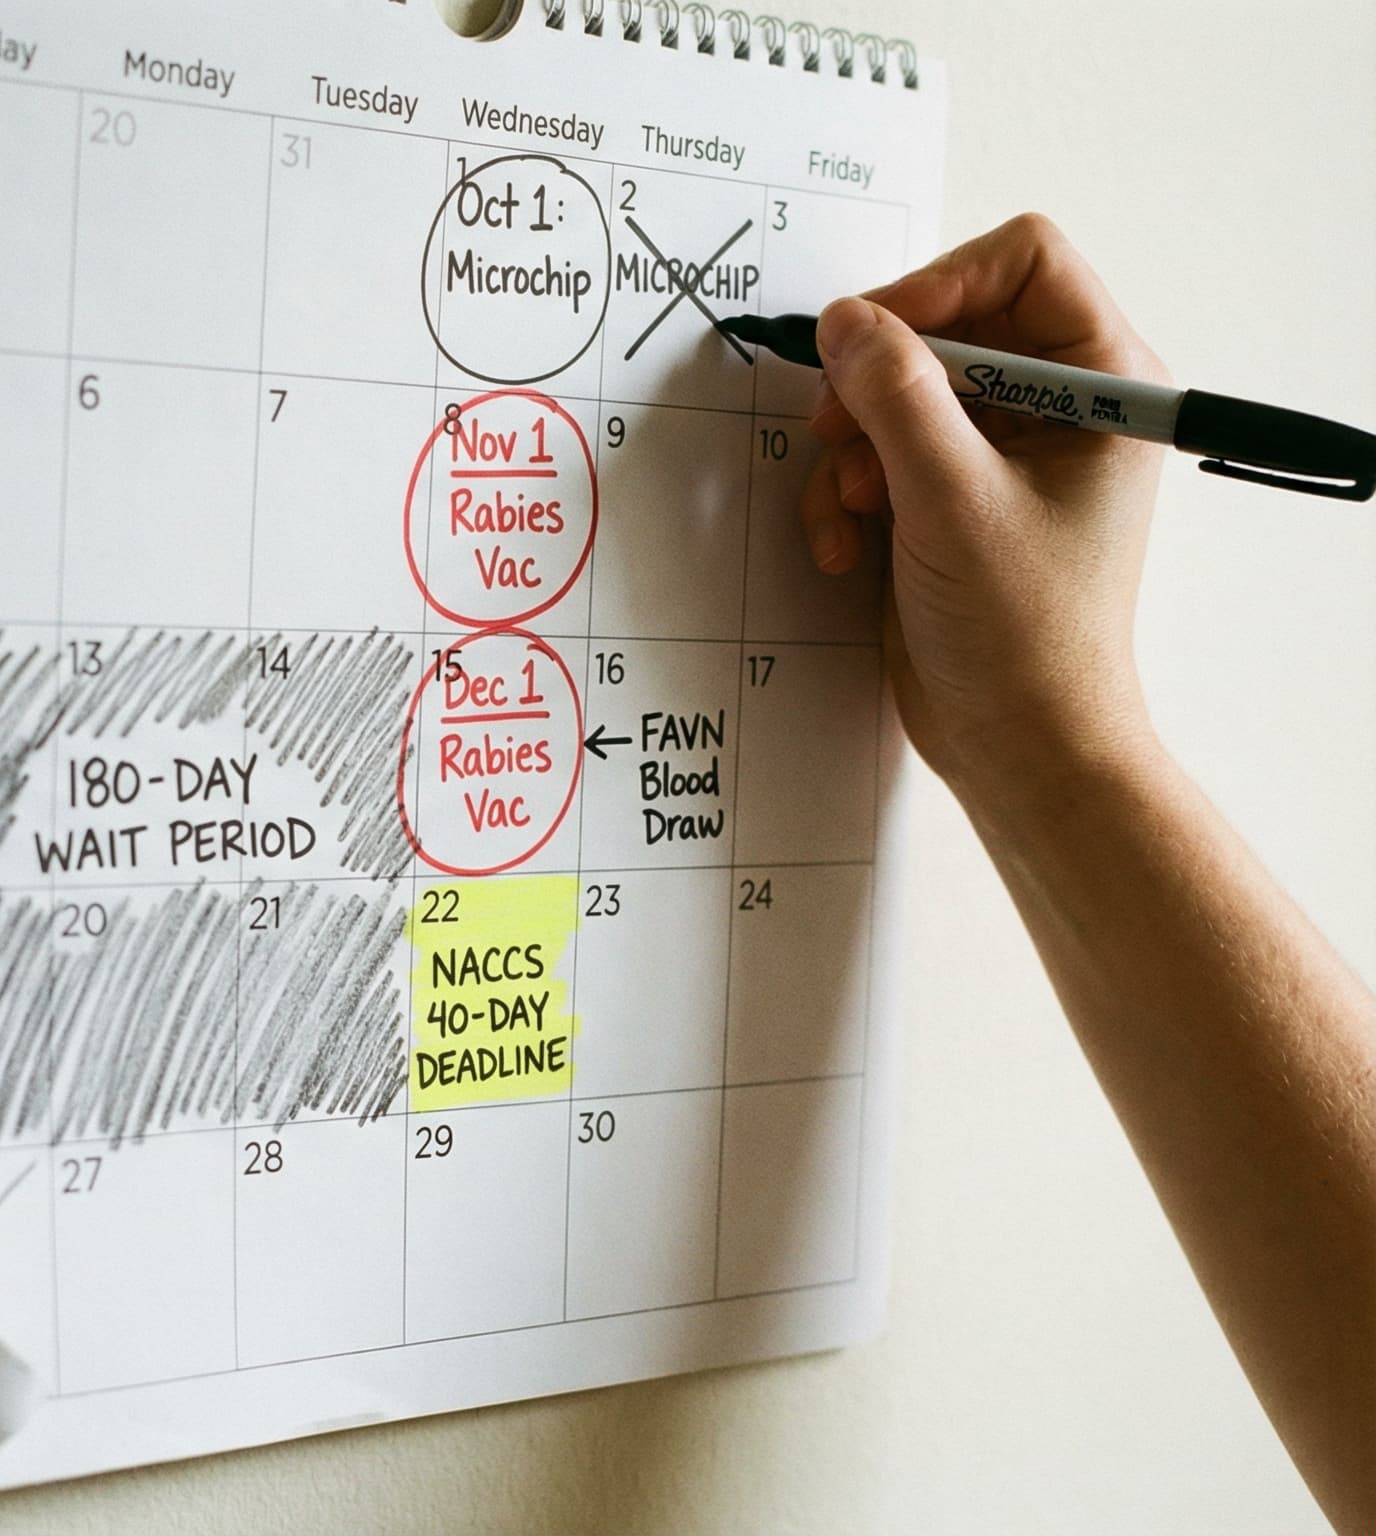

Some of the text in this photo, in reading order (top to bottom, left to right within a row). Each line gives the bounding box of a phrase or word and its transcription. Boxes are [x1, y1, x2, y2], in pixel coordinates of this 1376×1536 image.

[89, 108, 137, 147] 20
[123, 50, 236, 98] Monday
[311, 75, 420, 124] Tuesday
[462, 97, 605, 147] Wednesday
[641, 125, 746, 170] Thursday
[808, 150, 875, 189] Friday
[280, 133, 313, 169] 31
[457, 181, 564, 231] Oct 1:
[620, 180, 637, 211] 2
[771, 201, 788, 231] 3
[446, 250, 592, 314] Microchip
[615, 252, 760, 301] MICROCHIP
[78, 374, 100, 410] 6
[268, 389, 288, 422] 7
[444, 403, 462, 435] 8
[606, 417, 624, 448] 9
[451, 417, 553, 463] Nov 1
[760, 429, 788, 461] 10
[450, 488, 565, 536] Rabies
[474, 546, 541, 590] Vac
[69, 641, 103, 676] 13
[259, 646, 291, 680] 14
[432, 649, 463, 682] 15
[595, 653, 624, 685] 16
[748, 656, 776, 687] 17
[444, 658, 544, 710] Dec 1
[641, 709, 724, 752] FAVN
[439, 733, 553, 782] Rabies
[70, 754, 258, 807] 180-DAY
[640, 757, 720, 800] Blood
[464, 788, 531, 833] Vac
[642, 808, 723, 845] Draw
[36, 818, 316, 873] WAIT PERIOD
[421, 889, 460, 923] 22
[585, 885, 621, 917] 23
[739, 879, 773, 911] 24
[61, 903, 107, 938] 20
[249, 896, 281, 931] 21
[431, 944, 545, 988] NACCS
[427, 991, 549, 1038] 40-DAY
[416, 1036, 567, 1090] DEADLINE
[415, 1125, 454, 1160] 29
[577, 1111, 616, 1144] 30
[61, 1157, 102, 1193] 27
[243, 1140, 283, 1176] 28
